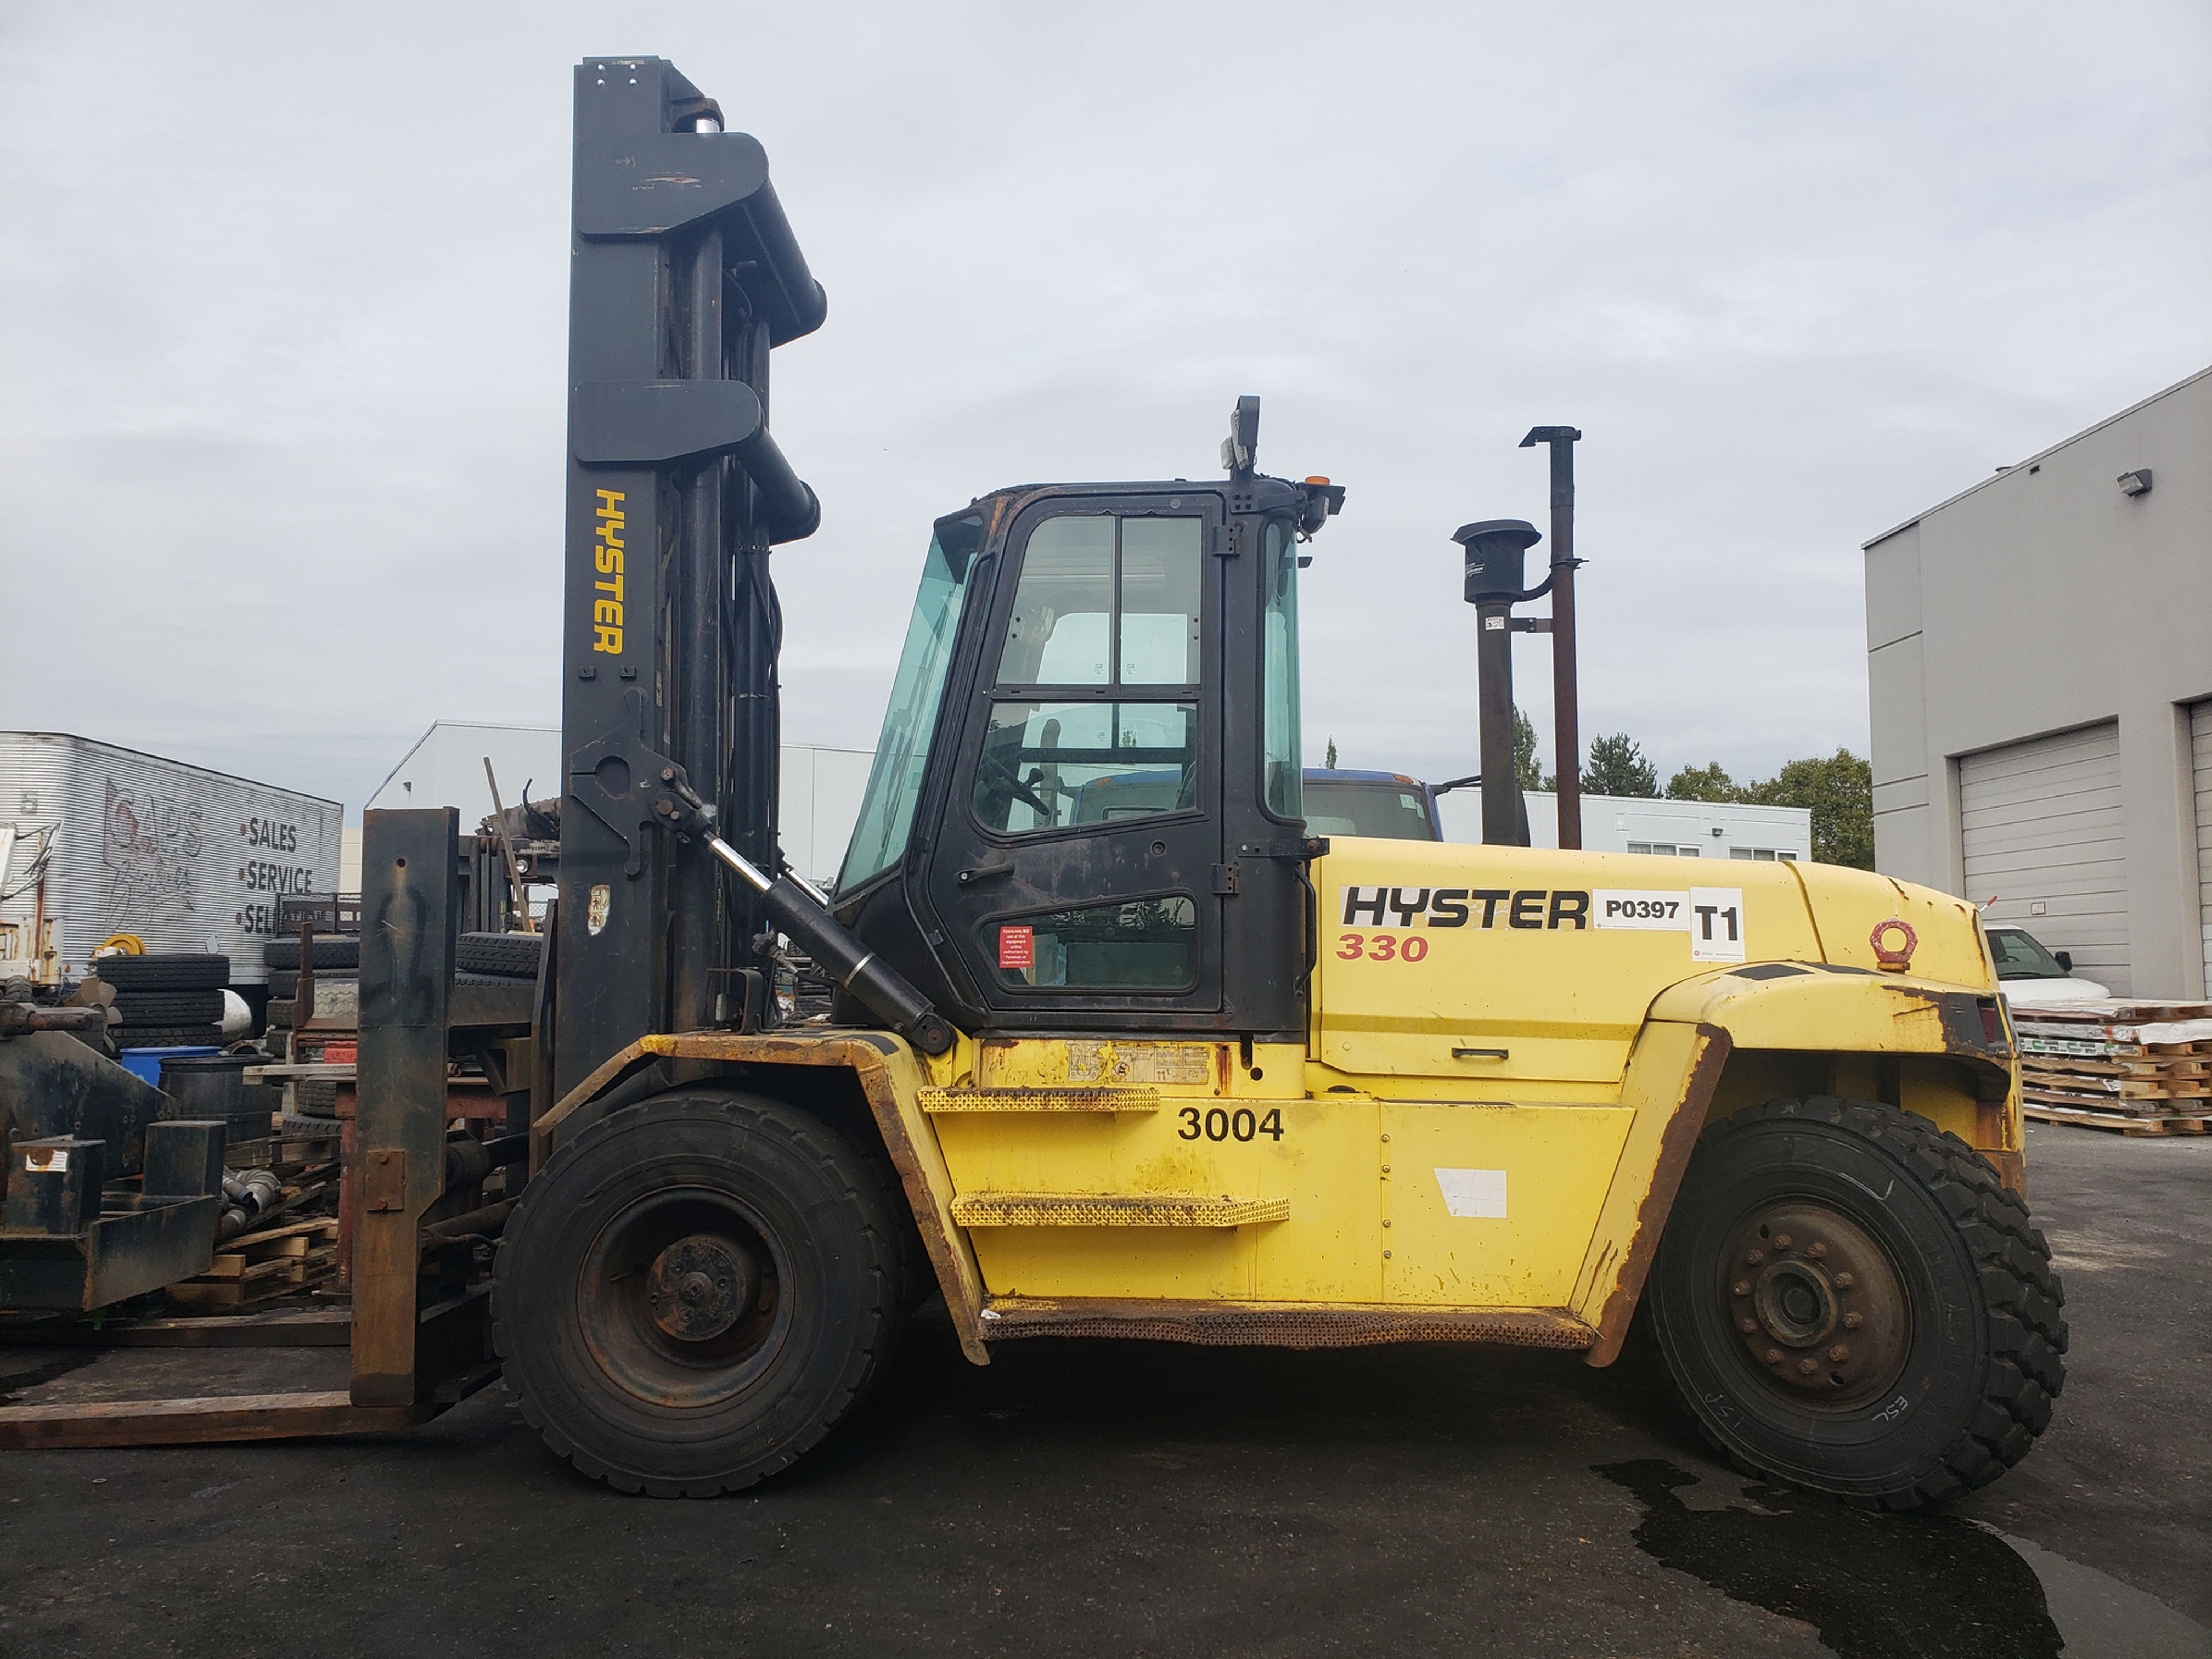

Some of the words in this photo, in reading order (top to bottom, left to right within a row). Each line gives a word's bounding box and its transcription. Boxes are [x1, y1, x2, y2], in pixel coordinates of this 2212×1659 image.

[594, 489, 625, 654] HYSTER
[249, 817, 296, 853] SALES
[247, 860, 313, 893] SERVICE
[1342, 887, 1589, 930] HYSTER
[1606, 900, 1679, 919] P0397
[1695, 906, 1738, 941] T1
[1336, 934, 1429, 962] 330
[1178, 1107, 1284, 1142] 3004
[1871, 1395, 1908, 1422] ESL
